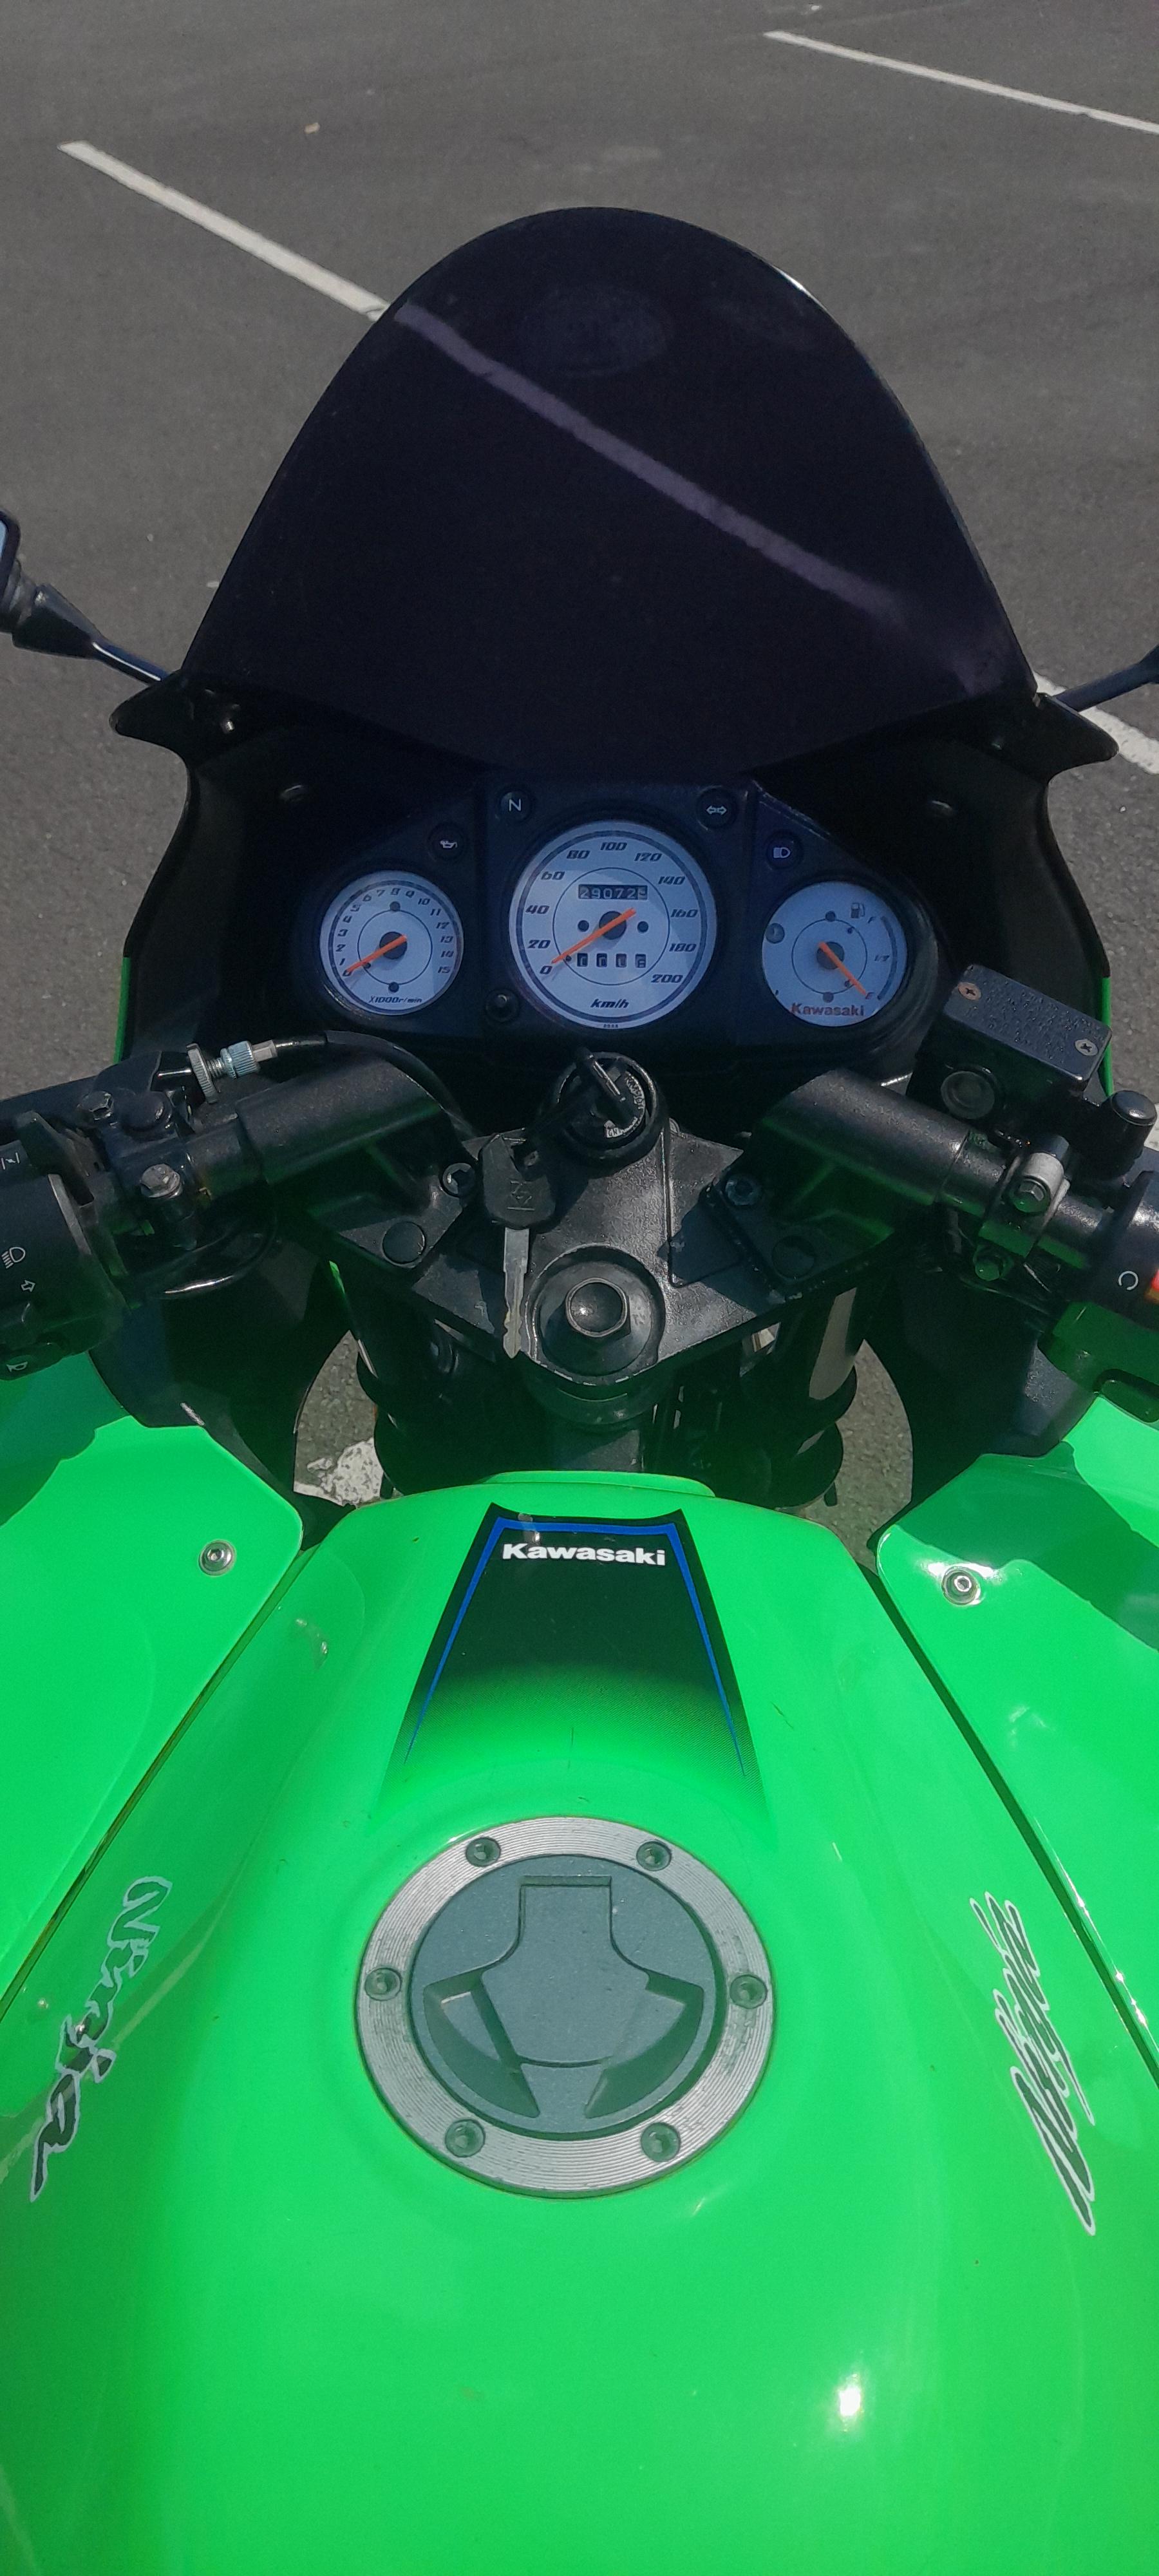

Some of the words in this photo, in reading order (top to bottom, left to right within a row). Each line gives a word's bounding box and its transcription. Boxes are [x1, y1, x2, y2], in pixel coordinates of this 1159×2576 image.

[508, 798, 522, 812] N
[599, 842, 628, 851] 100
[566, 849, 591, 859] 80
[633, 852, 663, 862] 120
[540, 871, 565, 881] 60
[657, 875, 686, 886] 140
[430, 908, 442, 916] 11
[525, 904, 549, 914] 40
[670, 909, 699, 918] 160
[343, 915, 353, 923] 4
[337, 929, 348, 937] 3
[335, 944, 346, 952] 2
[527, 939, 551, 950] 20
[668, 943, 697, 952] 180
[339, 958, 346, 966] 1
[539, 965, 552, 975] 0
[650, 974, 683, 984] 200
[590, 998, 629, 1009] km/h
[791, 1002, 865, 1017] Kawasaki
[502, 1543, 666, 1566] Kawasaki
[30, 1875, 173, 2203] Ninja
[969, 1891, 1096, 2237] Ninja
